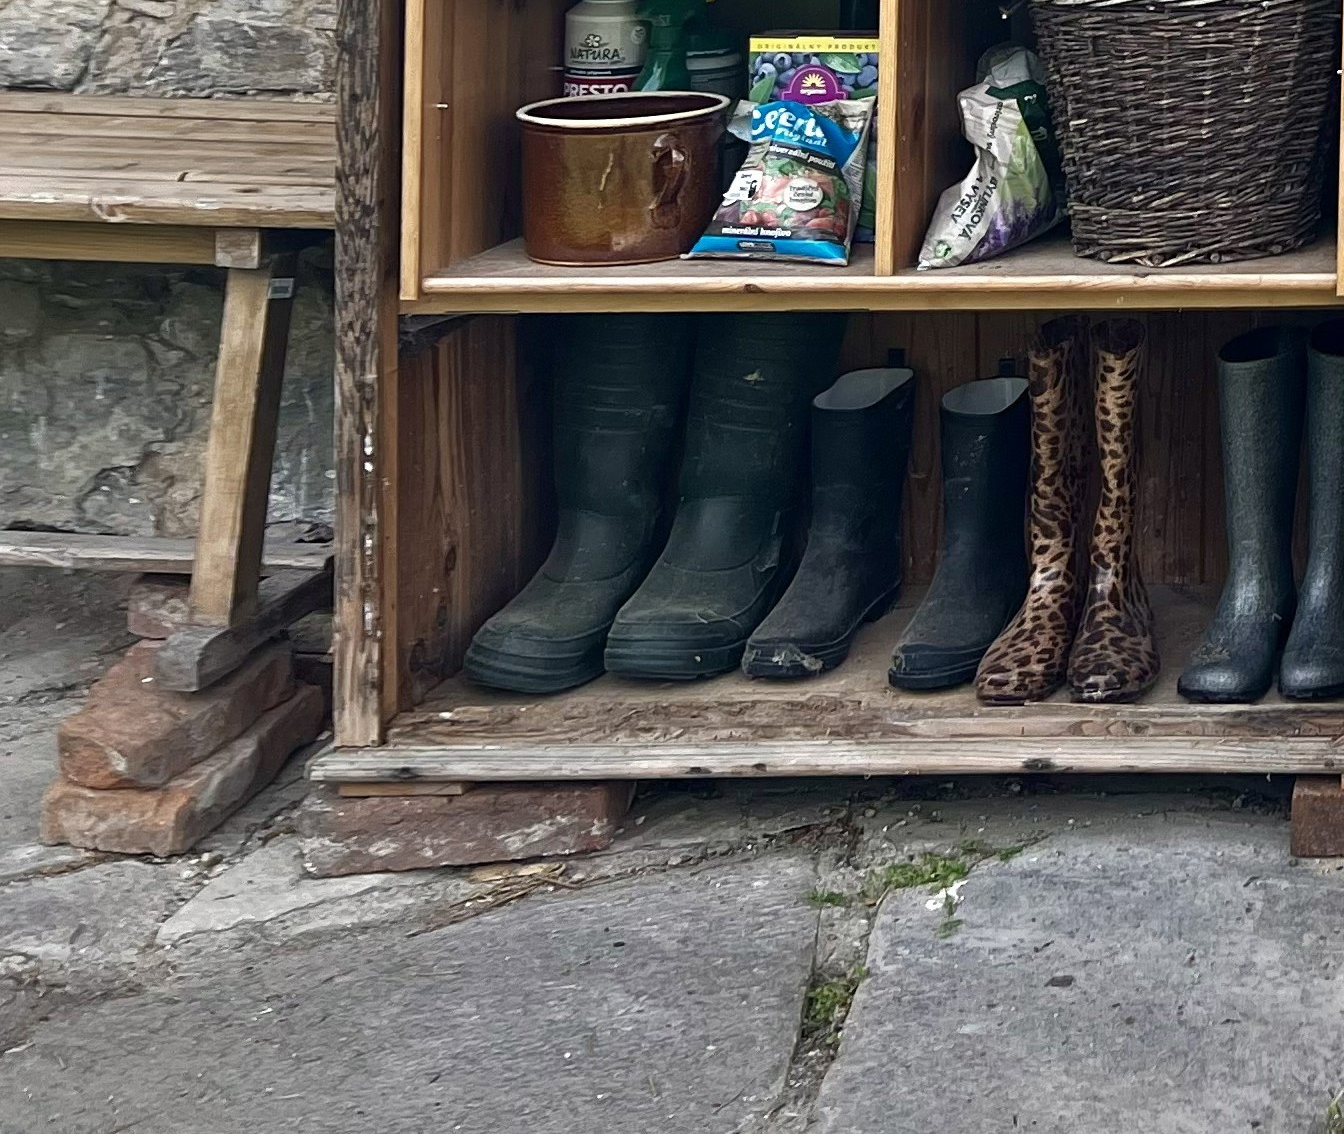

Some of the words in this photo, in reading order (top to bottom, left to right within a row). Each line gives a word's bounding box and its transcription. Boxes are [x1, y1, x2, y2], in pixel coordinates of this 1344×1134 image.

[570, 48, 620, 60] NATURA
[564, 82, 628, 97] PRESTO
[951, 185, 980, 224] VÝSEV
